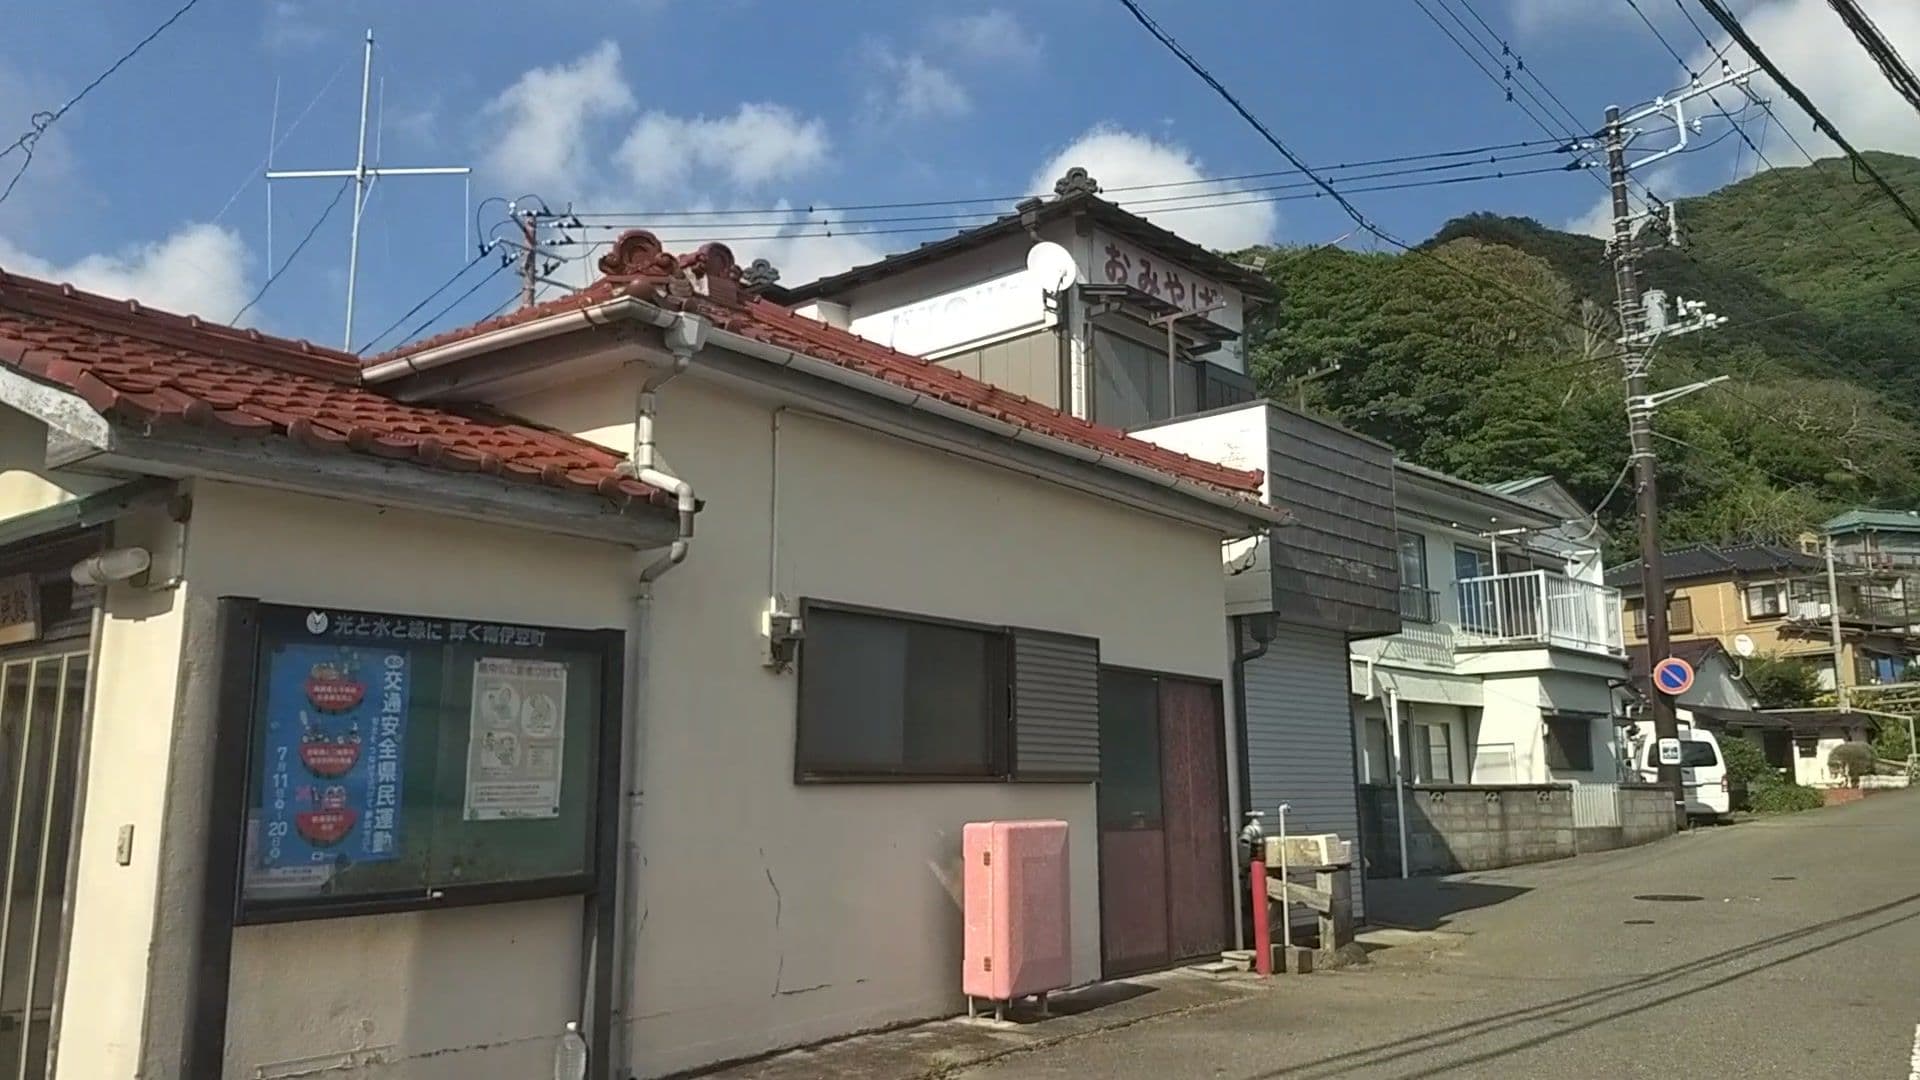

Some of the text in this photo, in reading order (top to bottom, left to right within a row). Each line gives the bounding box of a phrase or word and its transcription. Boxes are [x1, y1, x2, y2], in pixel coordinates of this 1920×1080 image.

[1104, 243, 1219, 311] おみやげ
[372, 671, 403, 853] 交通安全県民運動
